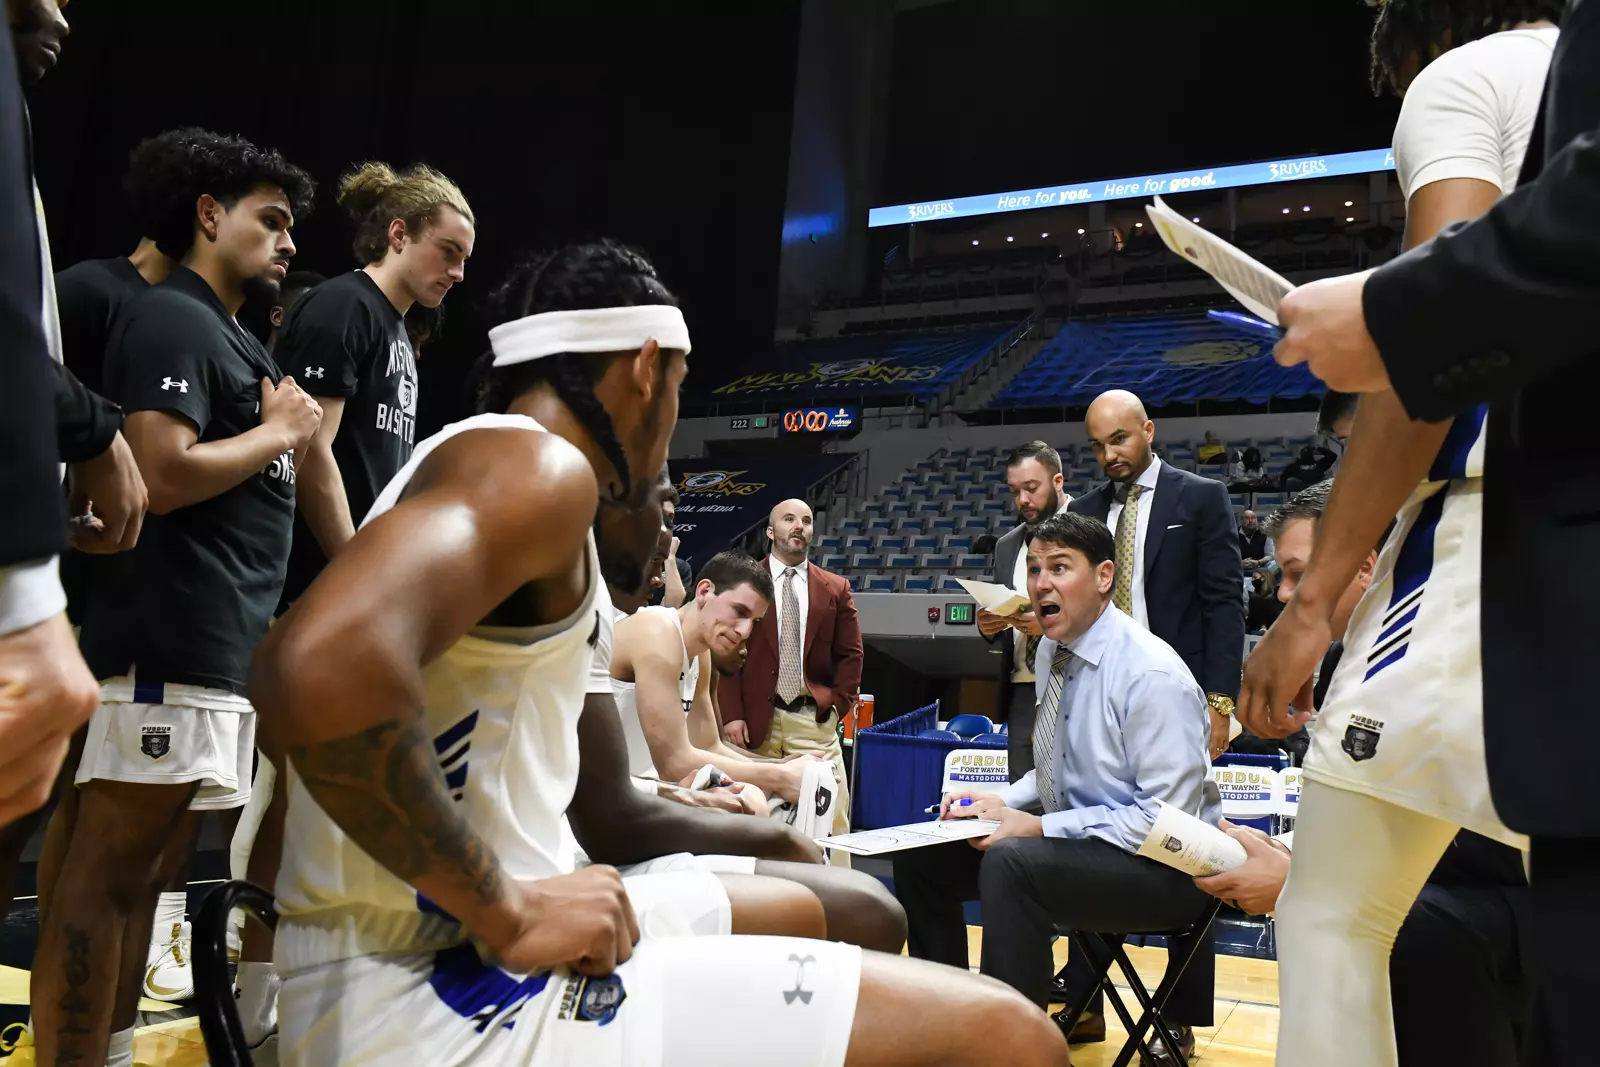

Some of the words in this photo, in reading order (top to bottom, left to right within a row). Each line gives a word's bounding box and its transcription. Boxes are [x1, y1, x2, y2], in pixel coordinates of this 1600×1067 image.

[1103, 183, 1139, 197] Here
[1144, 179, 1166, 194] for
[1169, 171, 1216, 192] good.
[997, 195, 1031, 209] Here
[1034, 191, 1057, 207] for
[1058, 188, 1092, 205] you.
[732, 419, 748, 429] 222
[951, 606, 969, 621] EXIT
[1350, 713, 1385, 729] PURDUE
[951, 755, 1007, 766] PURDU
